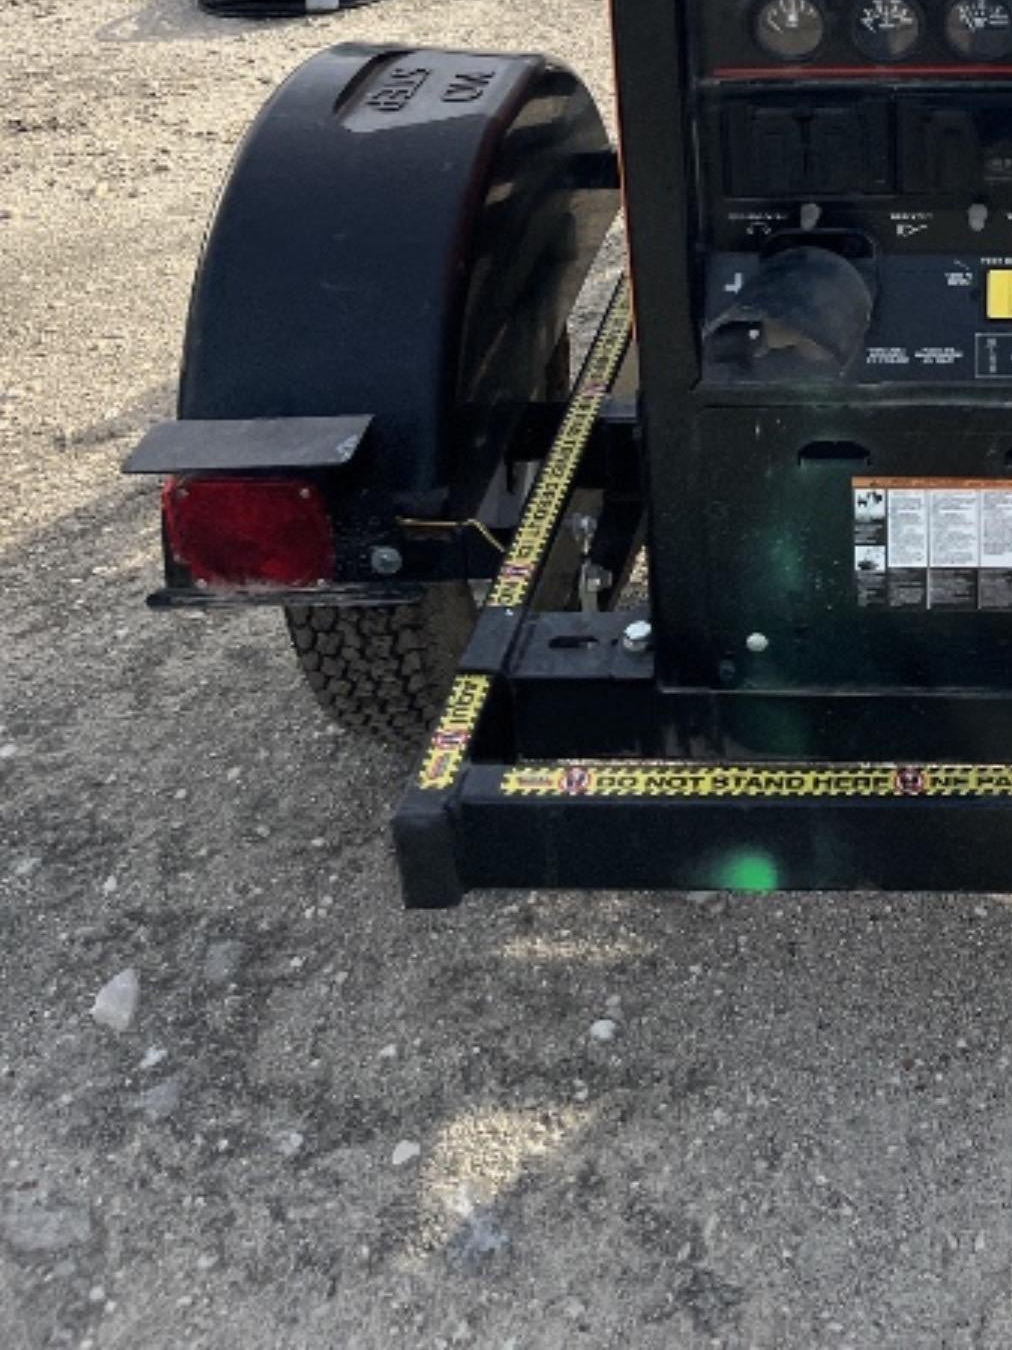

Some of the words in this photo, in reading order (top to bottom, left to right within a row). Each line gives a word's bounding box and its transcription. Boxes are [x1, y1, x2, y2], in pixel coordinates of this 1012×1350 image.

[597, 776, 636, 788] DO
[645, 776, 704, 788] NOT
[712, 776, 800, 789] STAND
[813, 776, 889, 789] HERE
[930, 776, 970, 787] NE
